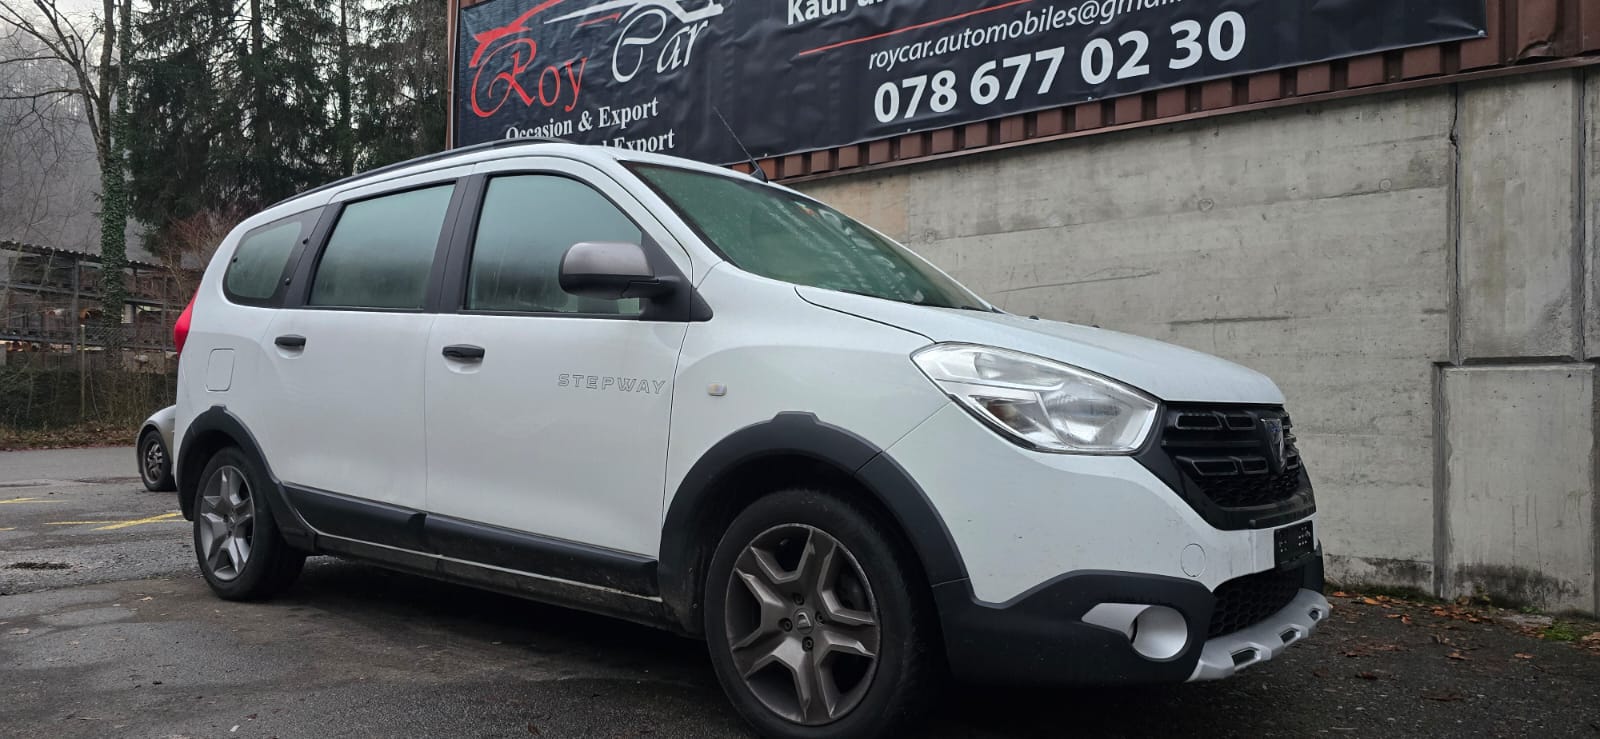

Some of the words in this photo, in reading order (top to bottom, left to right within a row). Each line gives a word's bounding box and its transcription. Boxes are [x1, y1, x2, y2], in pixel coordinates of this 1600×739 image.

[470, 37, 588, 118] Roy
[611, 8, 708, 83] Car
[874, 69, 958, 123] 078
[970, 46, 1065, 105] 677
[1080, 30, 1150, 85] 02
[1168, 10, 1247, 70] 30
[577, 110, 593, 132] &
[598, 96, 659, 130] Export
[558, 374, 666, 394] STEPWAY
